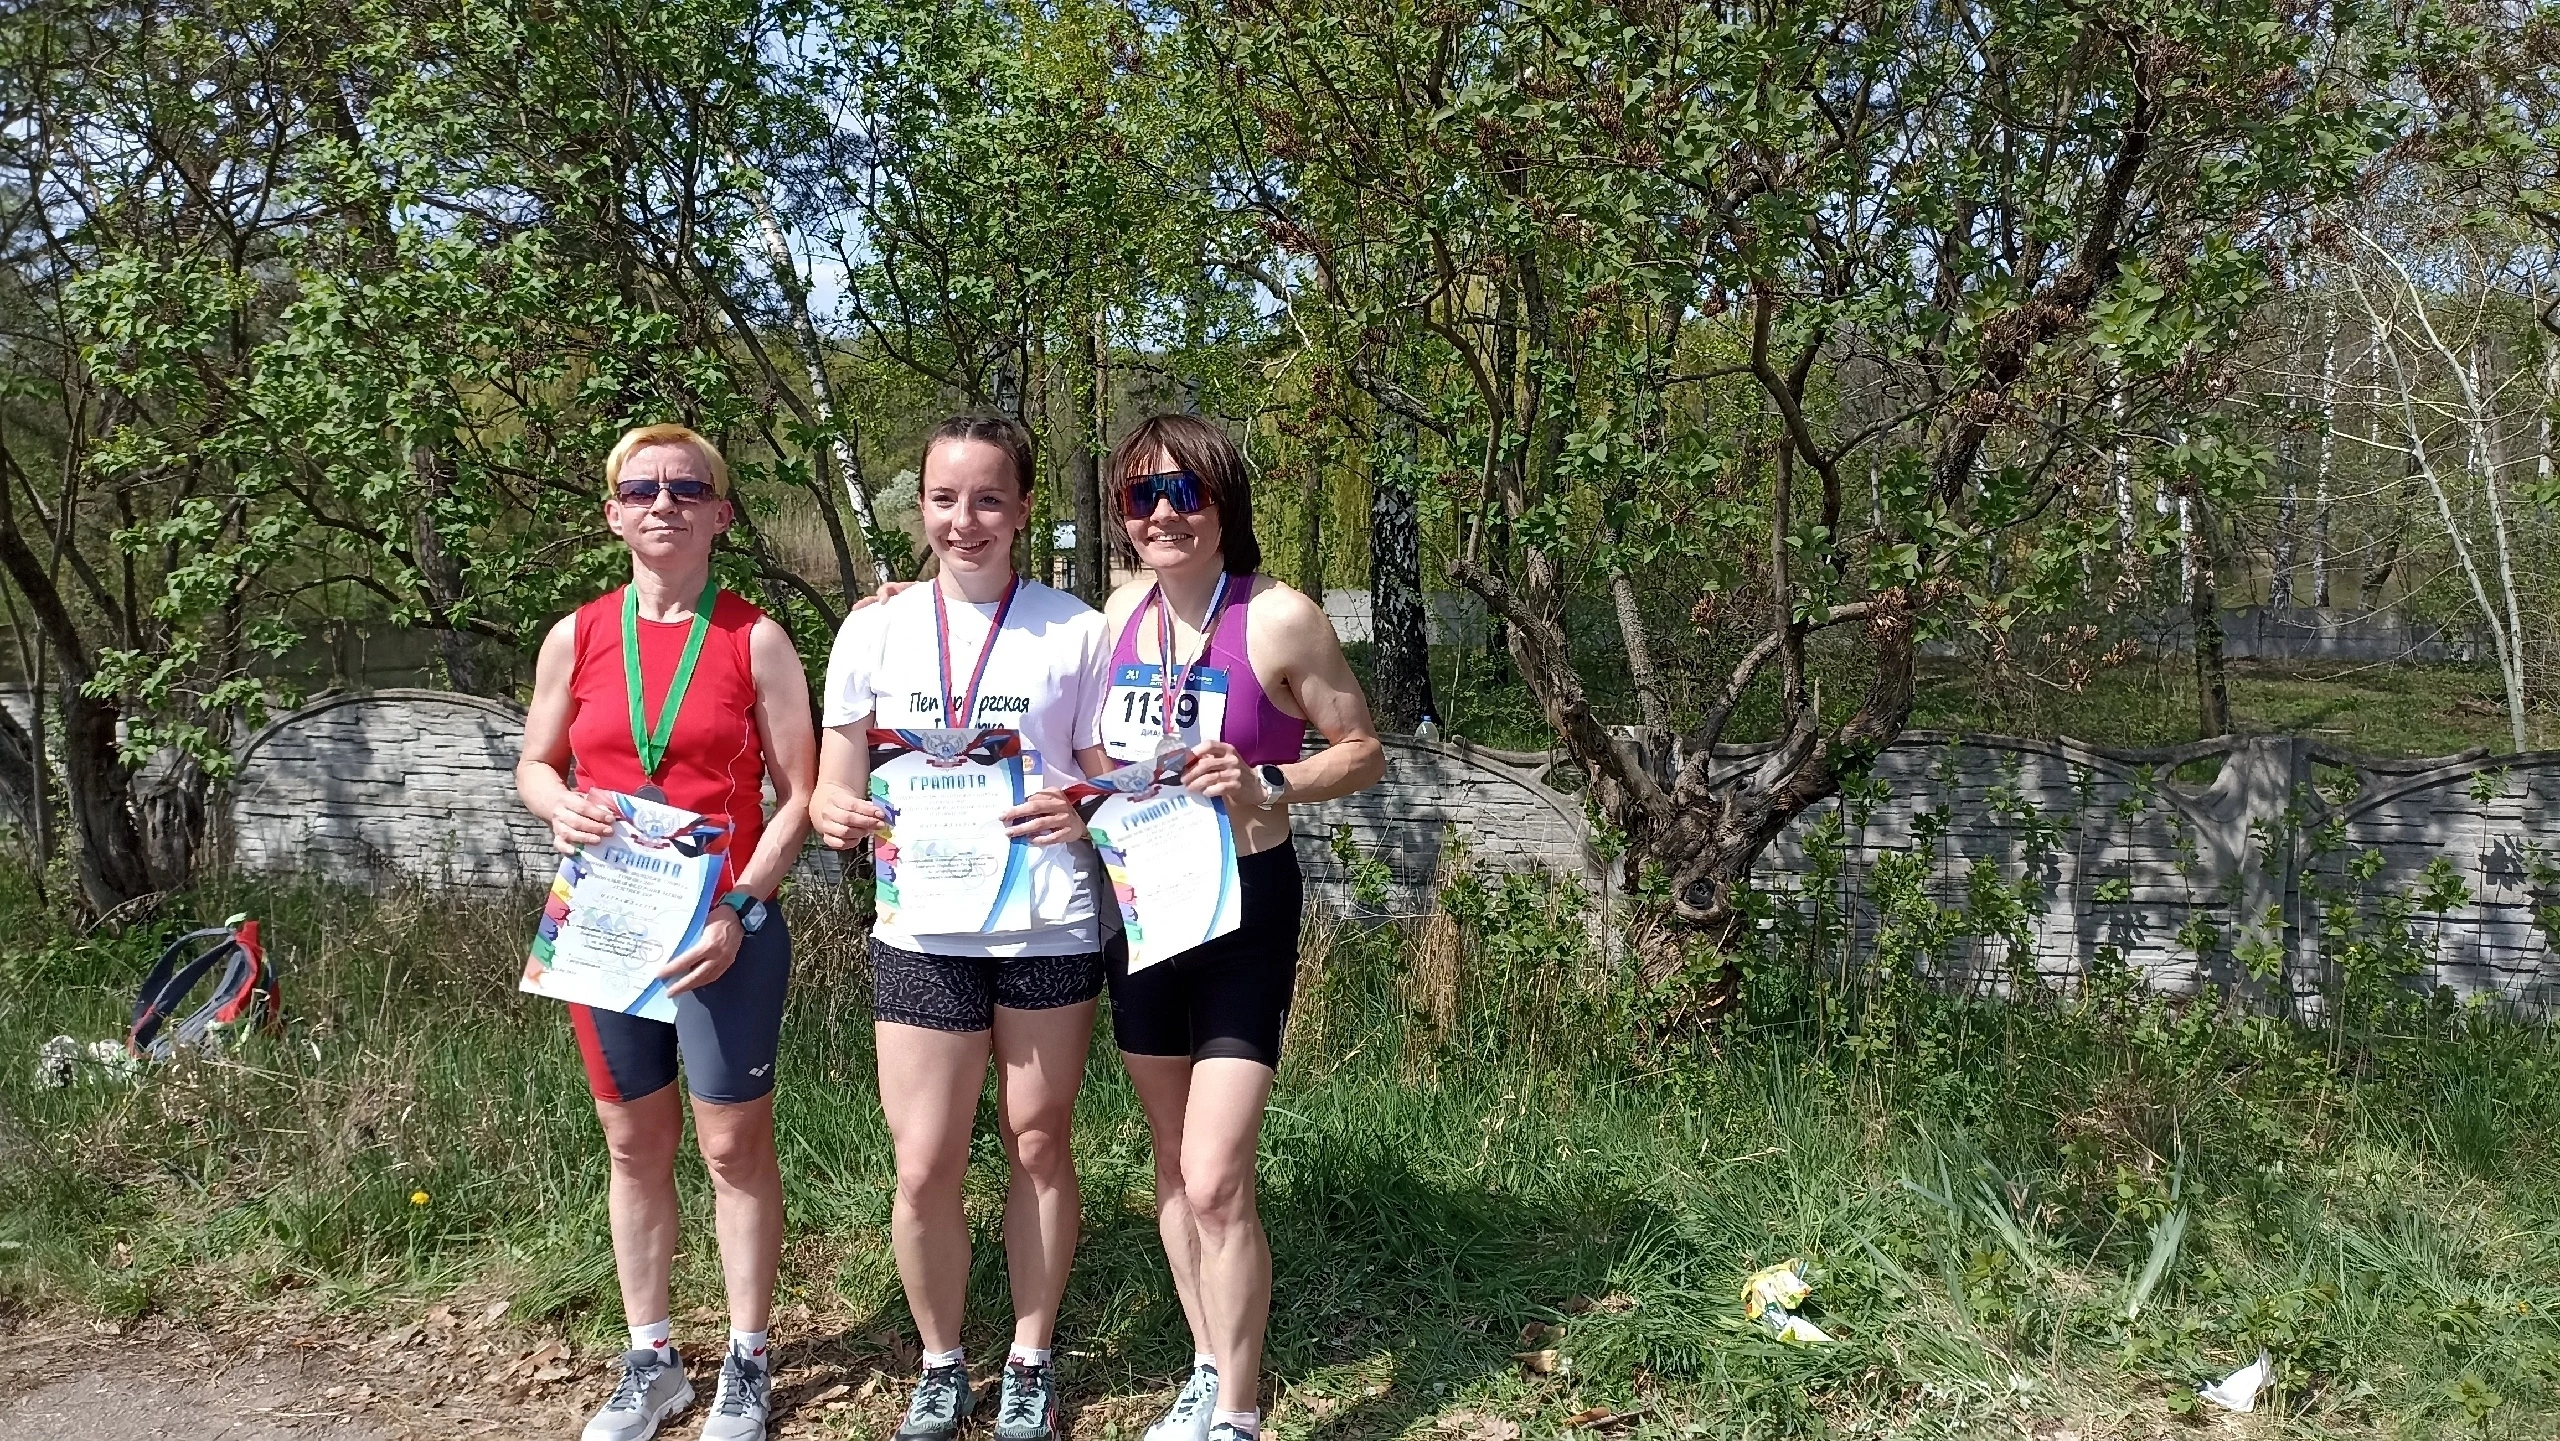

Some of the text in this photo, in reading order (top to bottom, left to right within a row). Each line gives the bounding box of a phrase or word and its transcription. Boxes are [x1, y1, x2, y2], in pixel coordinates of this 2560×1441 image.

[909, 774, 986, 792] ГРАМОТА
[1121, 794, 1189, 831] ГРАМОТА
[604, 846, 683, 878] ГРАМОТА
